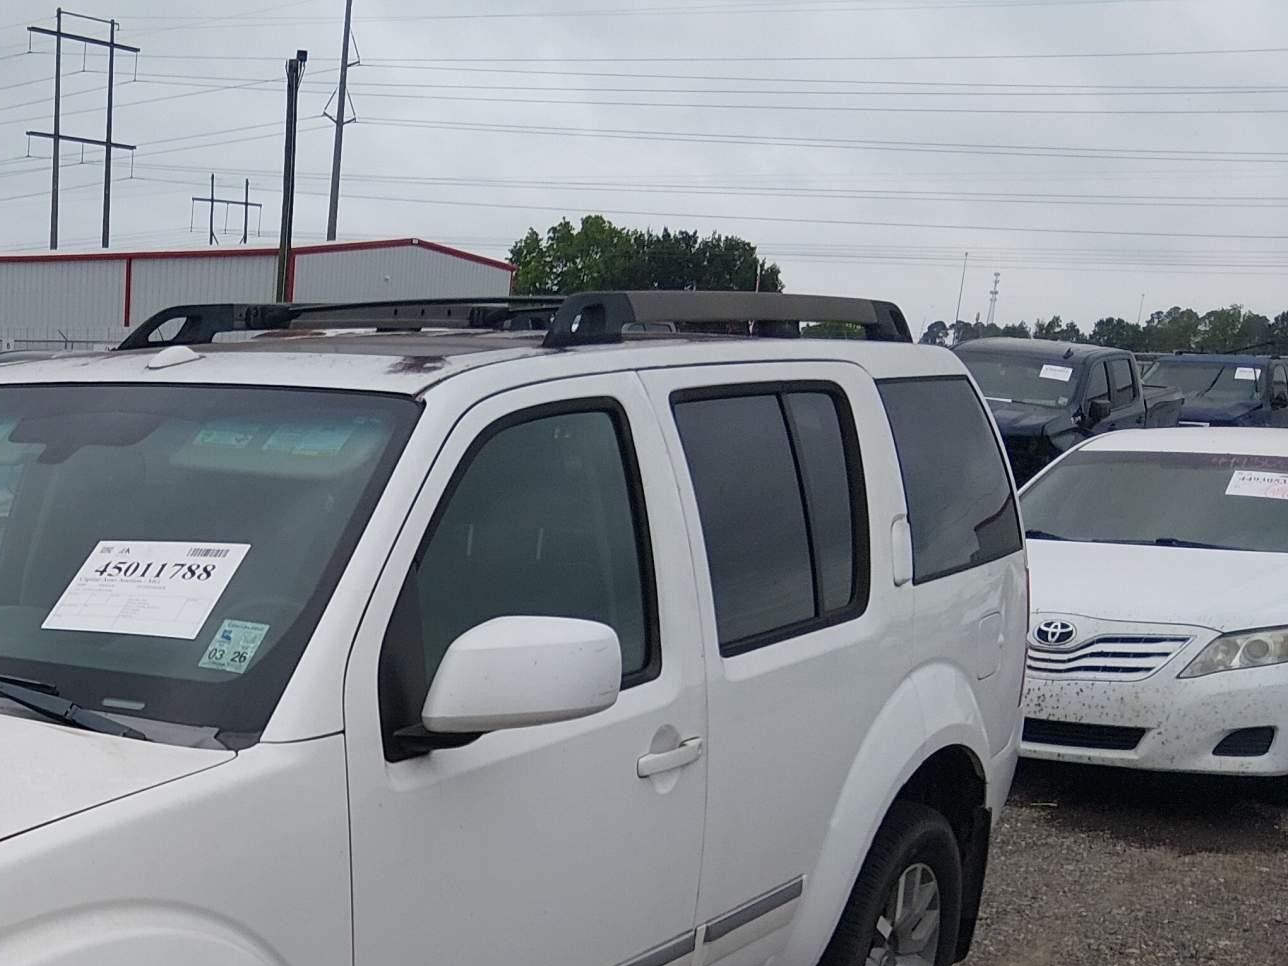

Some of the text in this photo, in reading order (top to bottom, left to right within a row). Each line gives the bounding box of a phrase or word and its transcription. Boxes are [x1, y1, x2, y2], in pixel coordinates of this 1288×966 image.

[95, 561, 216, 581] 45011788
[208, 648, 248, 663] 03 26
